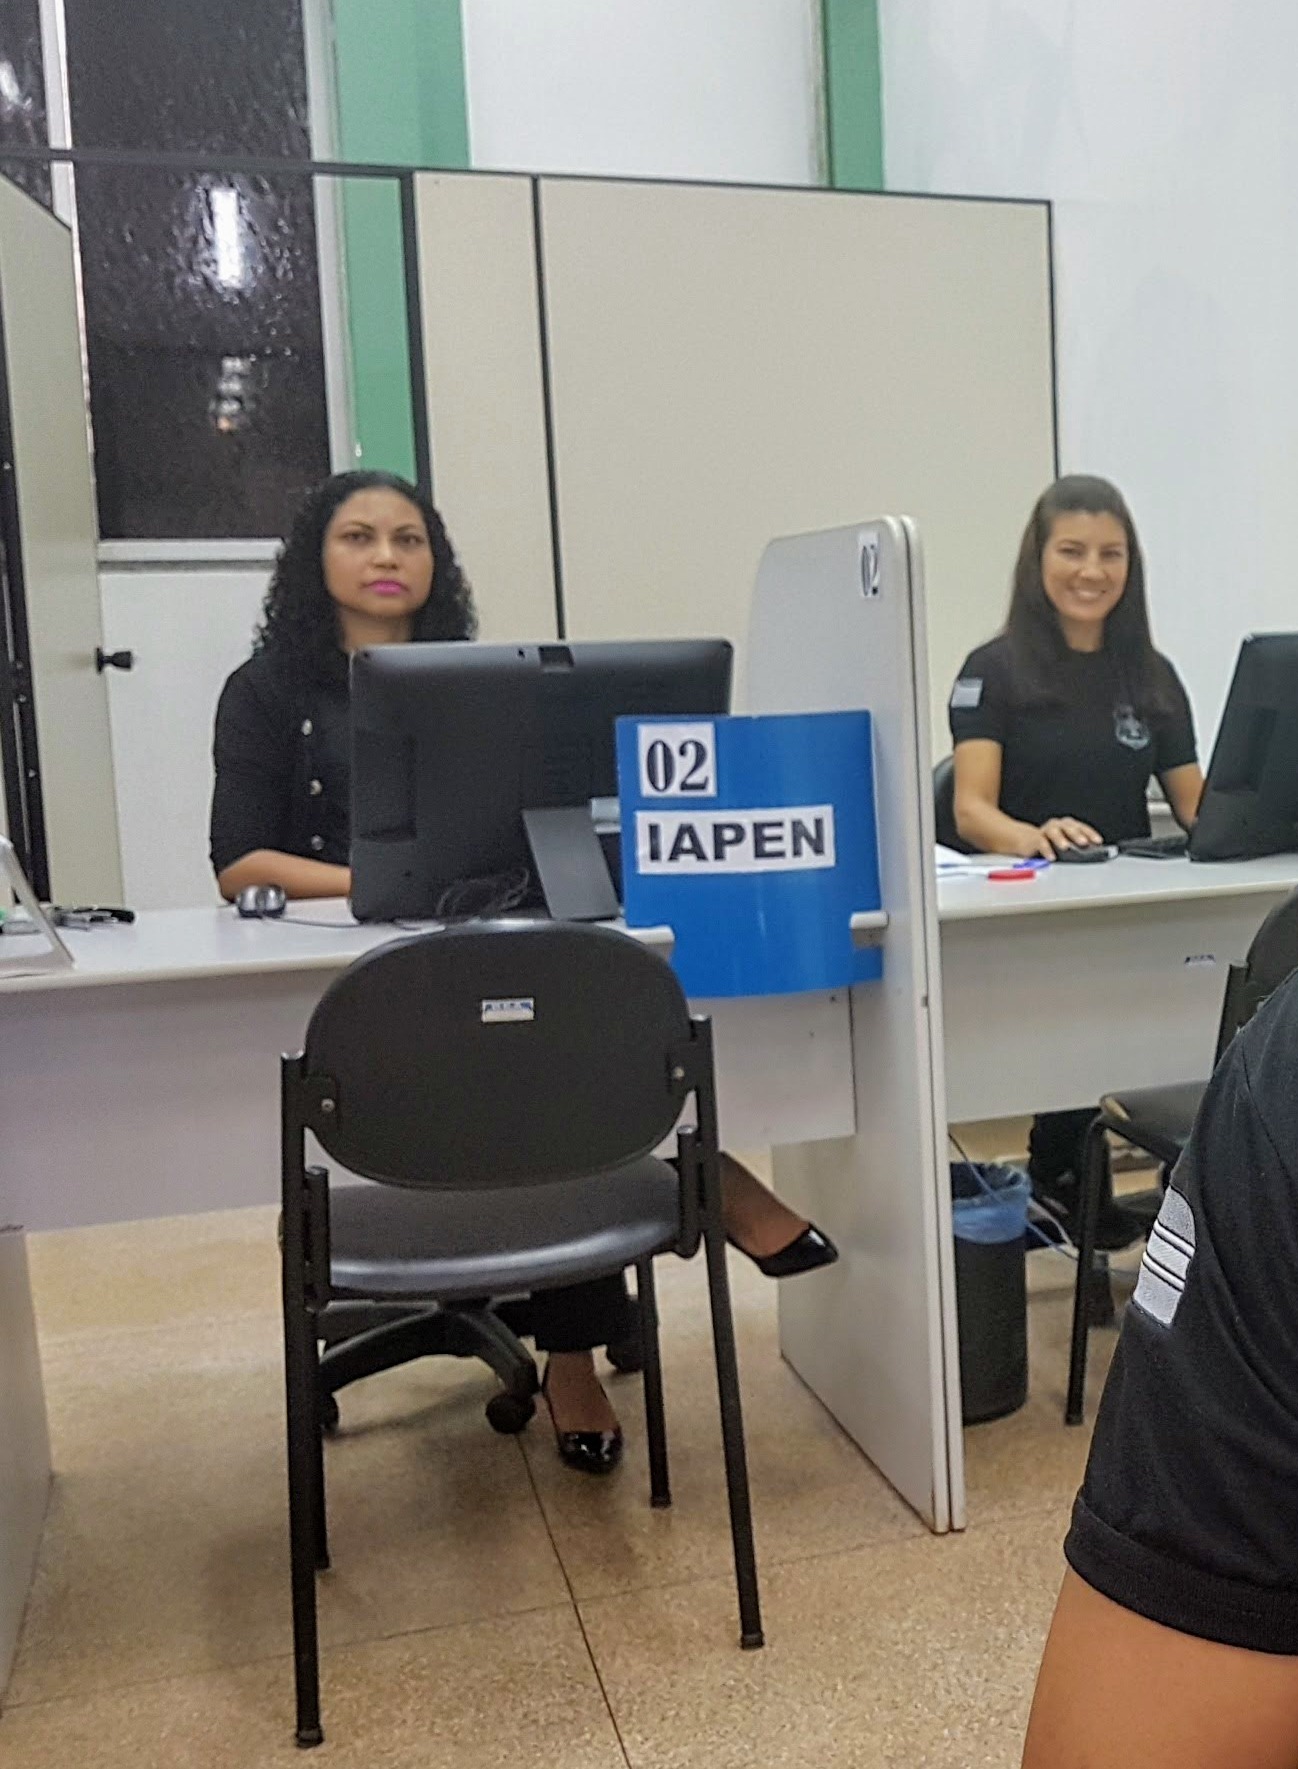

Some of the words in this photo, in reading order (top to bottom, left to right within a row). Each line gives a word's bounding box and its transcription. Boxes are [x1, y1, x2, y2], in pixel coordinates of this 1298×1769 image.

[861, 545, 879, 597] 02
[646, 739, 708, 792] 02
[648, 817, 825, 862] IAPEN
